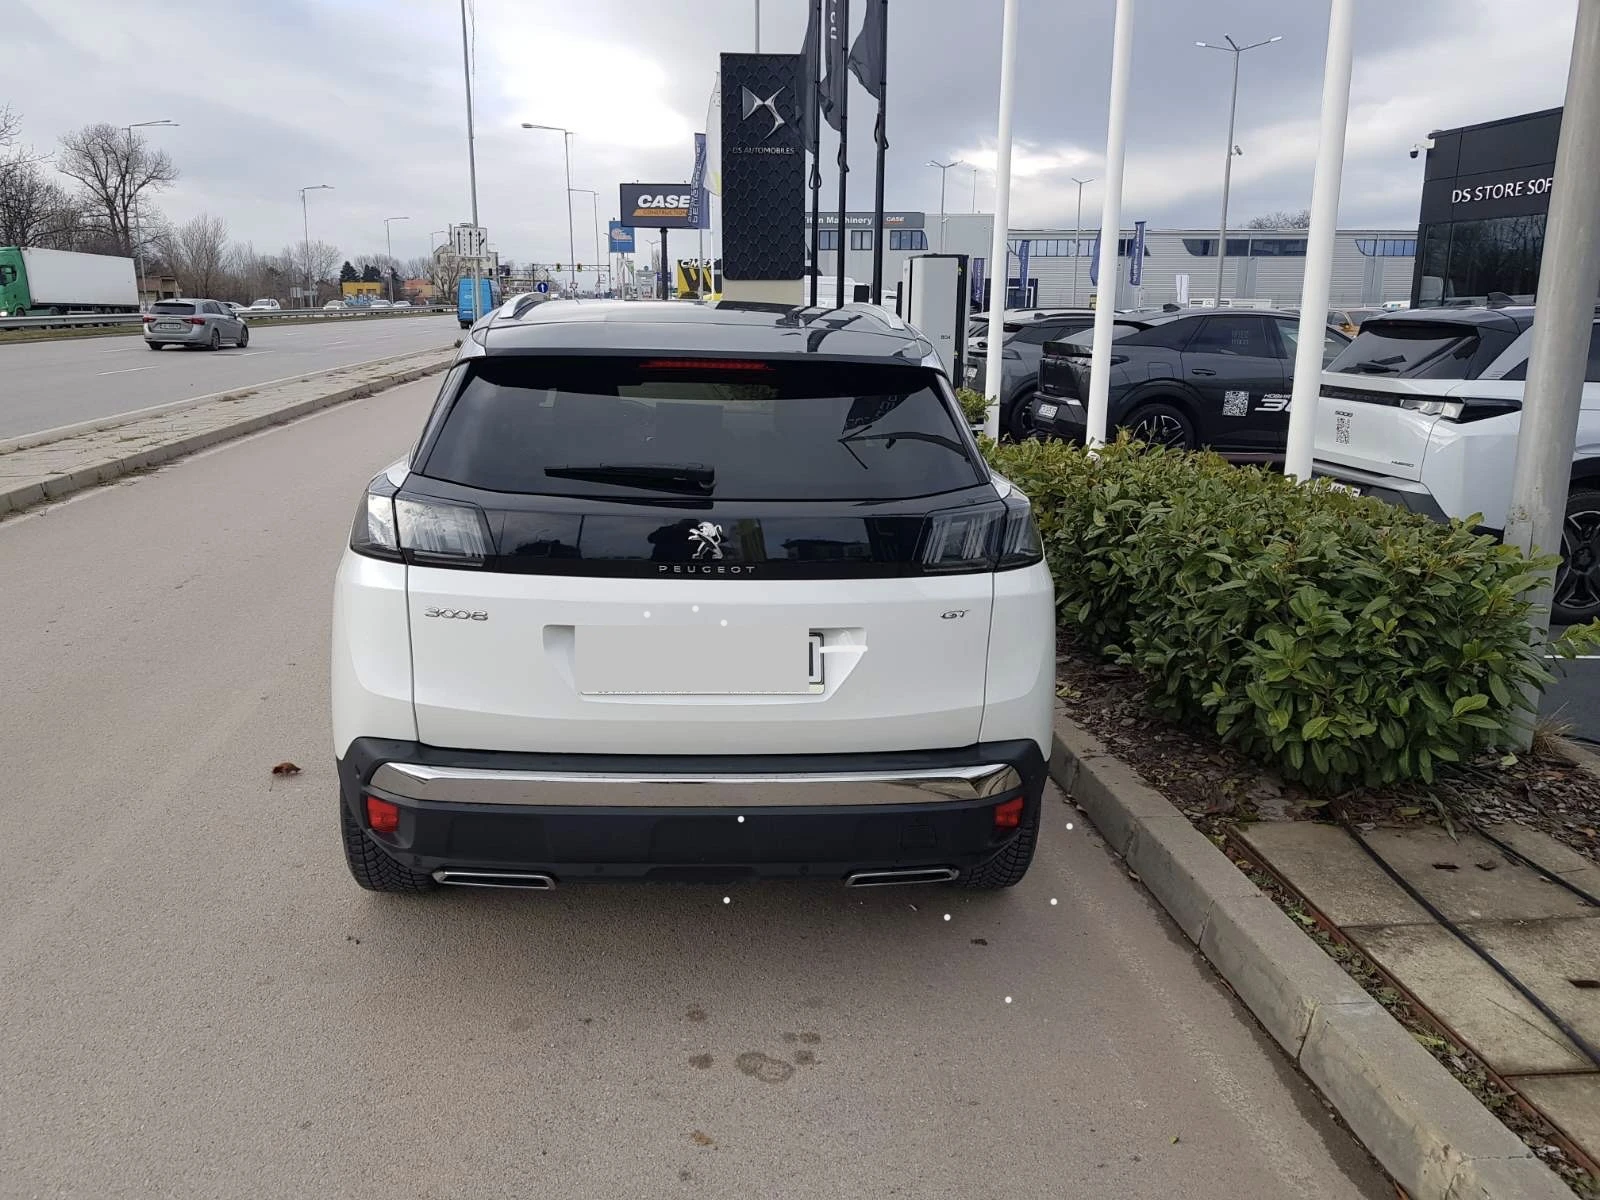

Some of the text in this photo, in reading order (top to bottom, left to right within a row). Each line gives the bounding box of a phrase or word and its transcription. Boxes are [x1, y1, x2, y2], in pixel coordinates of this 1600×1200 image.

[1452, 189, 1471, 204] DS
[1474, 181, 1524, 201] STORE
[637, 194, 691, 208] CASE
[826, 216, 873, 225] Mahinery
[658, 565, 755, 574] PEUGEOT
[424, 606, 488, 621] 3008
[940, 609, 970, 619] GT
